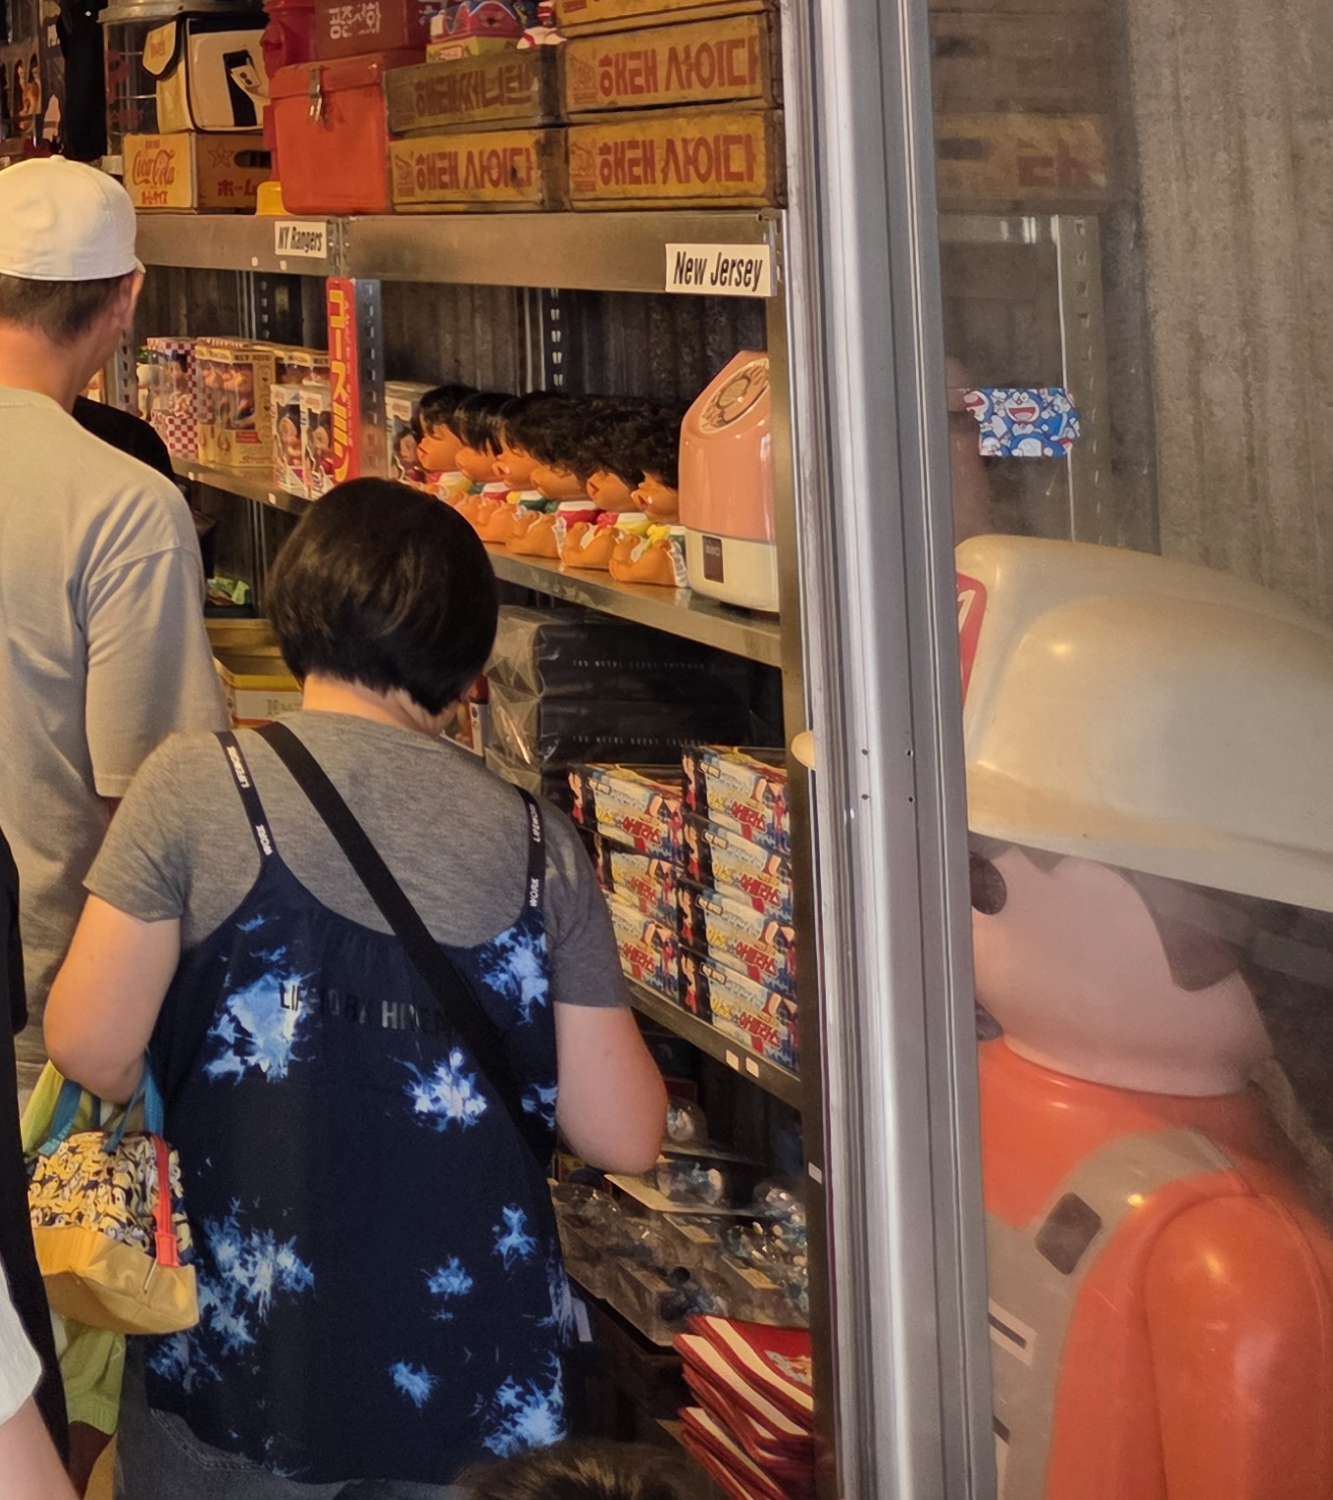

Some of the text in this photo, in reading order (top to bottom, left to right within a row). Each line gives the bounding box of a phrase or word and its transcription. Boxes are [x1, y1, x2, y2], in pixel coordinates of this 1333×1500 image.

[598, 34, 759, 97] 해태 사이다
[415, 147, 533, 192] 해태 사이다
[598, 133, 756, 186] 해태 사이다
[291, 227, 323, 254] Rangers
[673, 251, 763, 292] New Jersey
